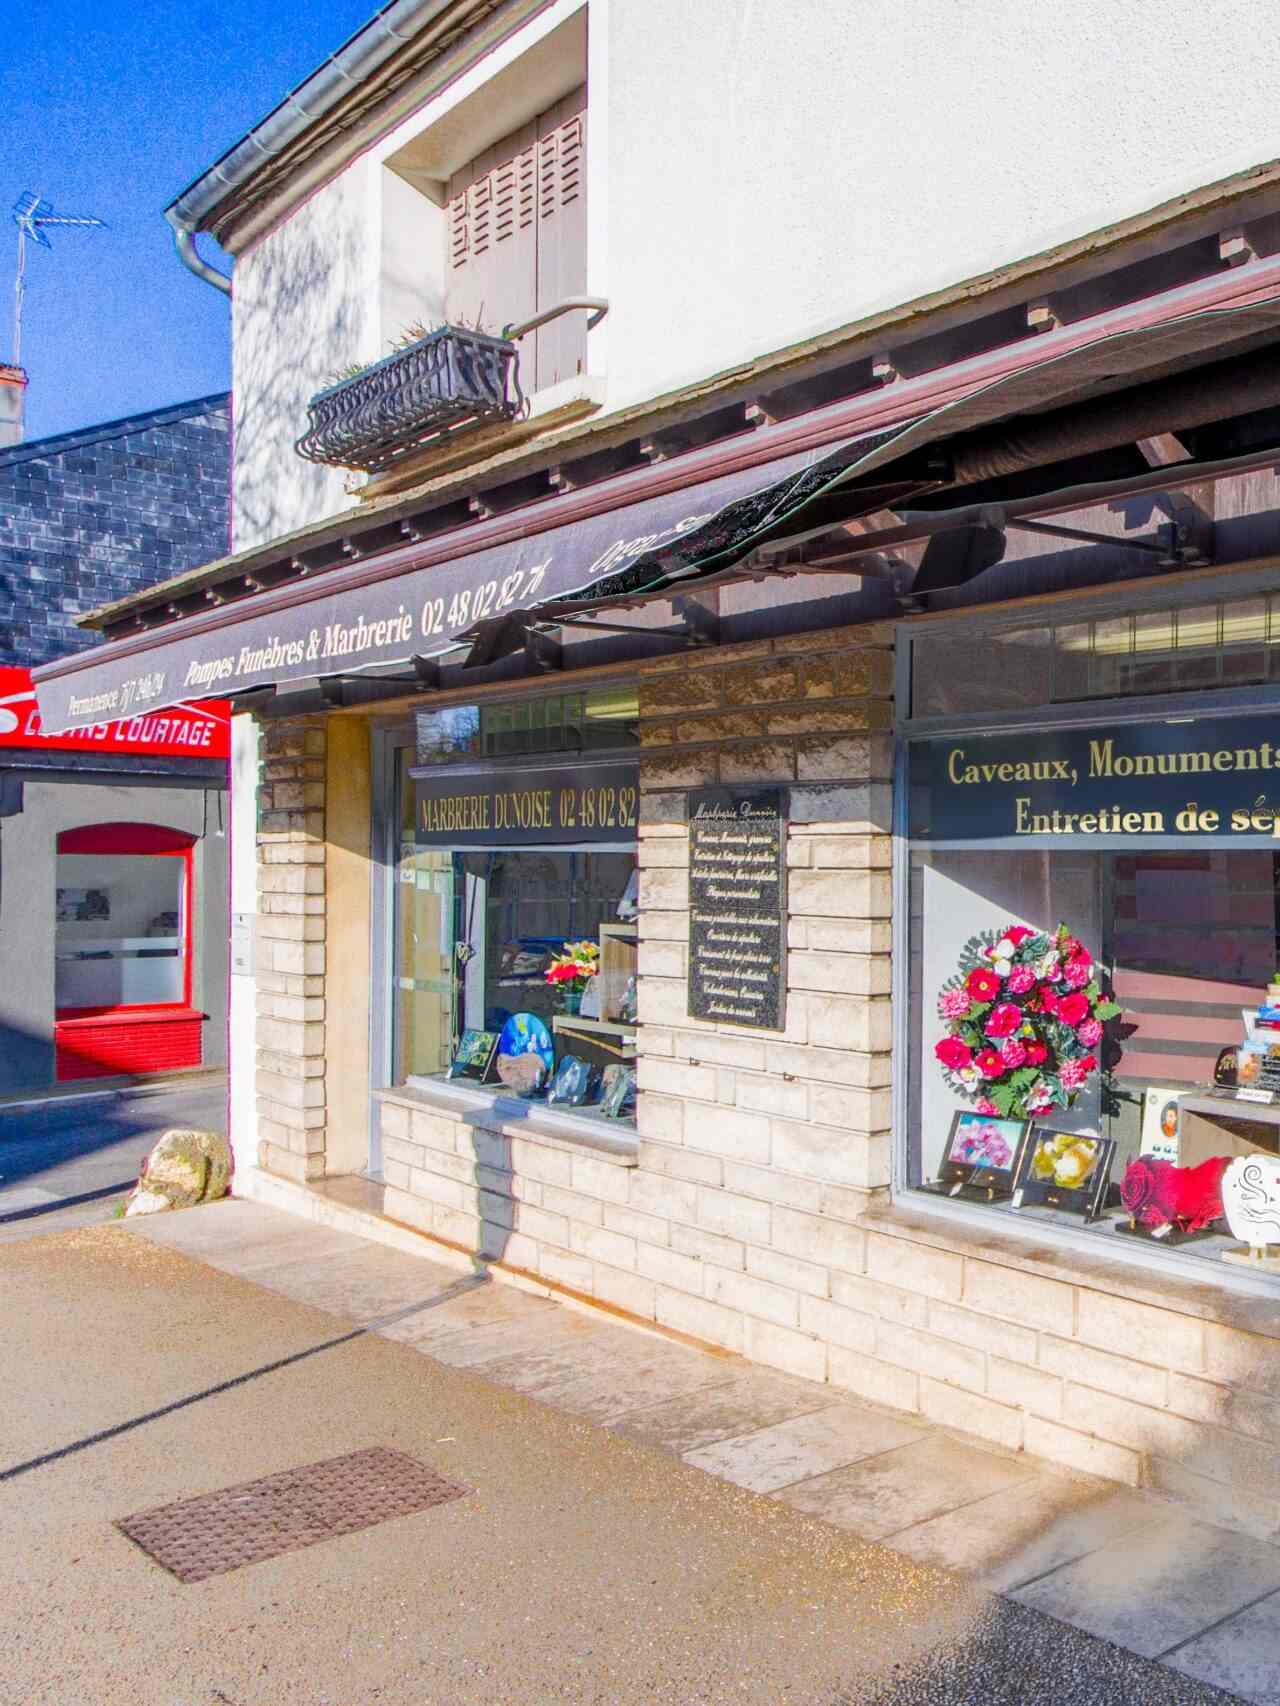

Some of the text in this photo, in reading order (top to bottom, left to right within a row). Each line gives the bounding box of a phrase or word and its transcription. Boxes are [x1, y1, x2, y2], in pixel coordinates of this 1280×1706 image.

[184, 656, 234, 689] Pompes
[235, 636, 305, 677] Funèbres
[306, 628, 322, 661] &
[321, 605, 413, 659] Marbrerie
[422, 598, 445, 637] 02
[448, 590, 472, 628] 48
[471, 580, 498, 621] 02
[495, 570, 525, 611] 82
[114, 716, 216, 746] COURTAGE
[948, 749, 1078, 786] Caveaux,
[421, 786, 636, 832] MARBRERIE DUNOISE 02 48 02 82
[1014, 797, 1166, 835] Entretien
[1174, 801, 1220, 832] de
